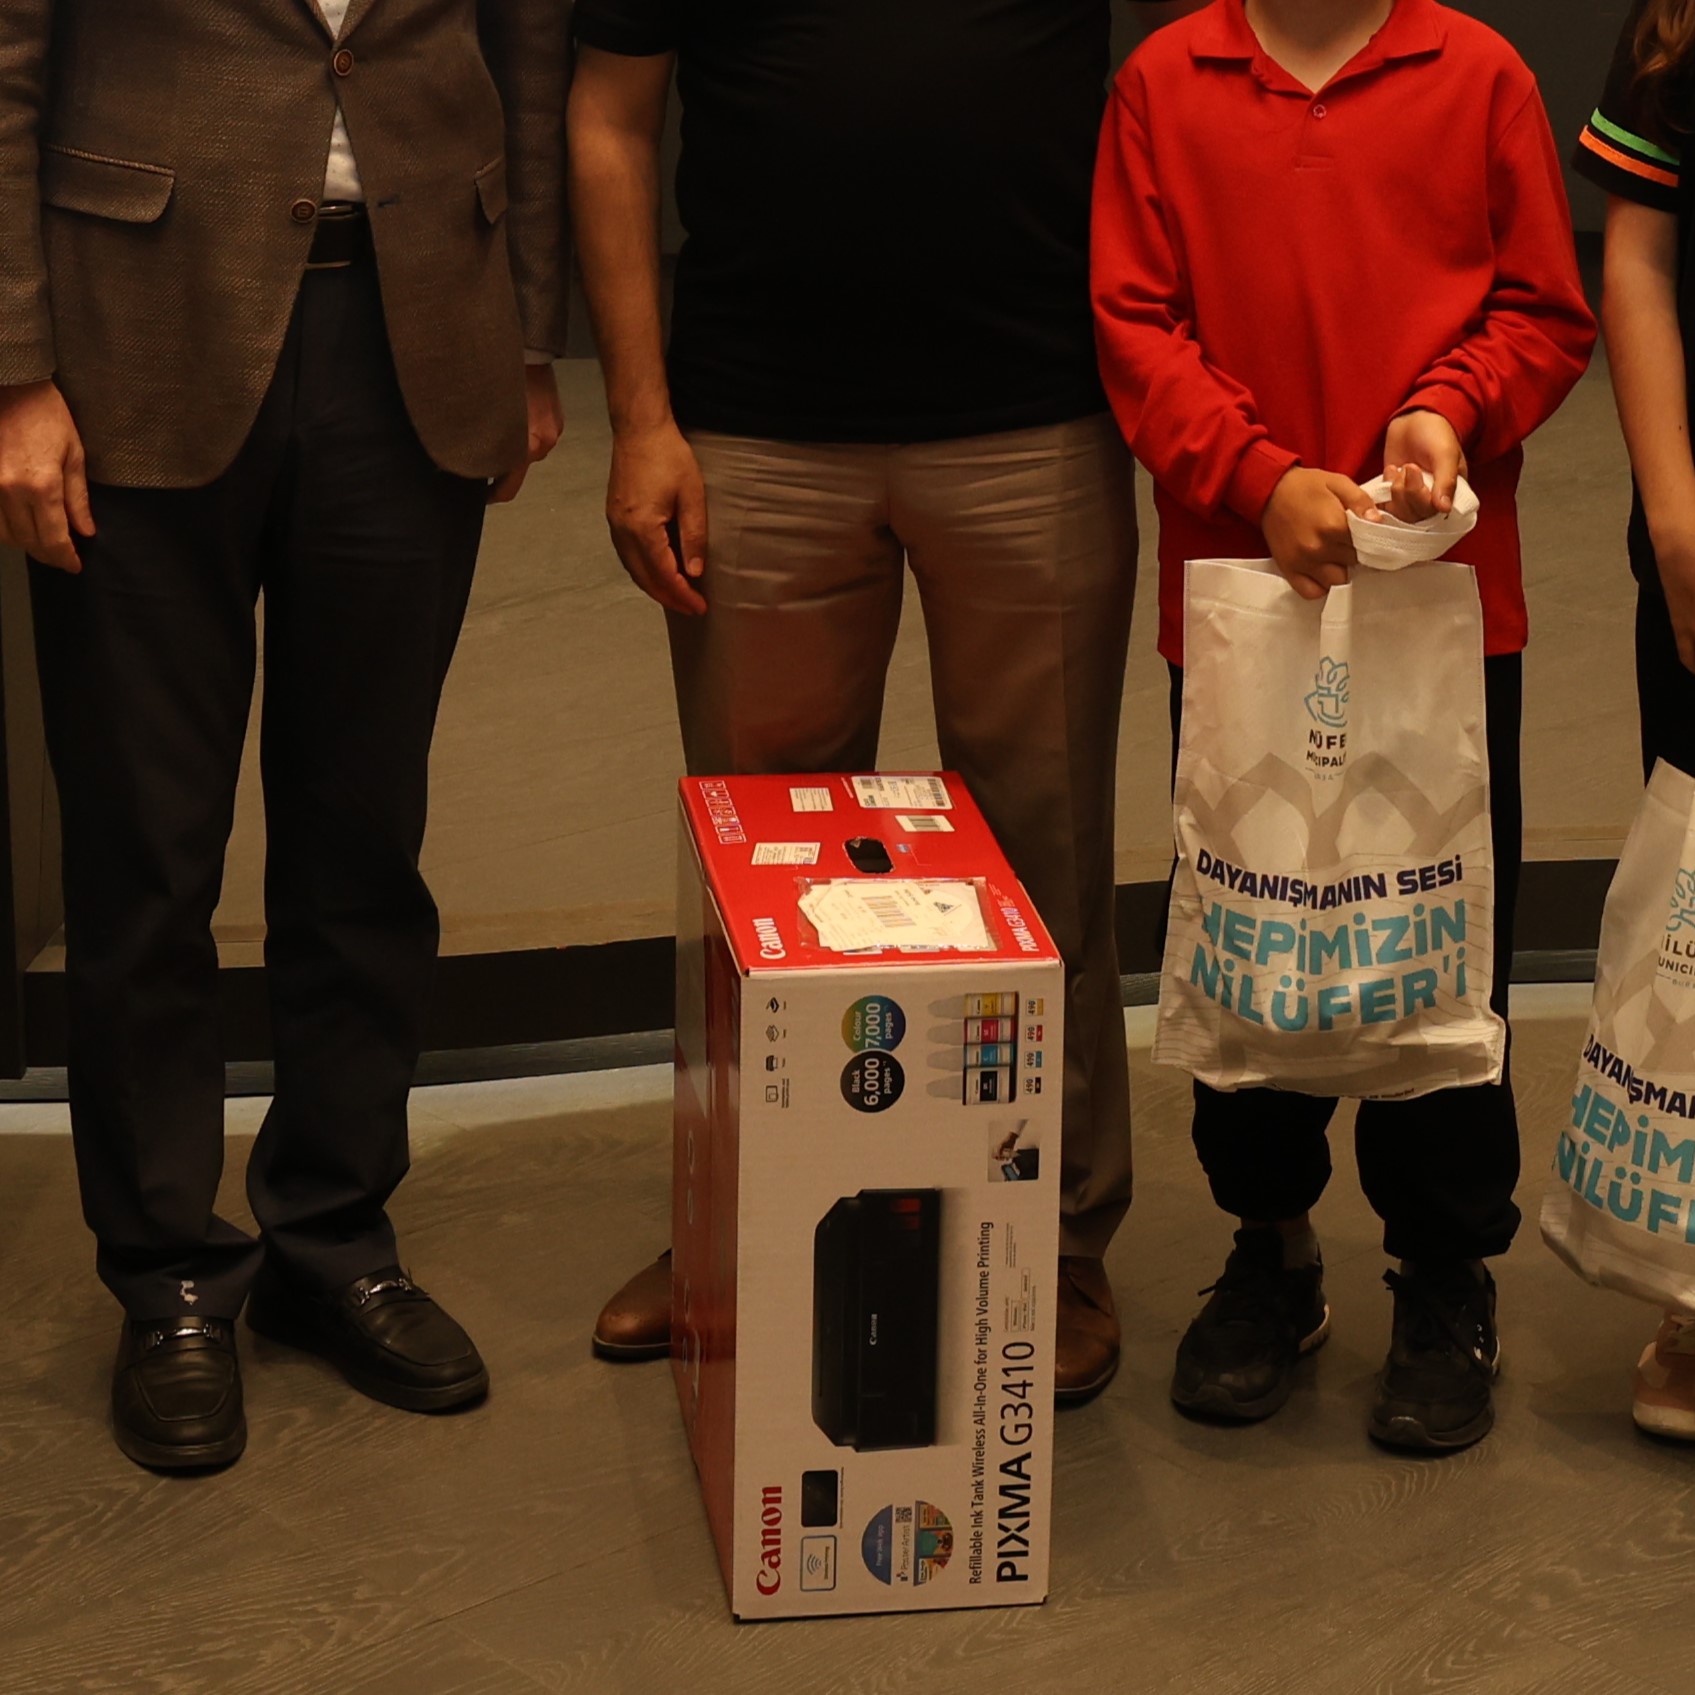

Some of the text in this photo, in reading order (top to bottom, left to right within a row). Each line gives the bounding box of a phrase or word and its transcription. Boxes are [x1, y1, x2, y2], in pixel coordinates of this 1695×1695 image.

[1196, 848, 1463, 911] DAYANIŞMANIN SESİ
[752, 917, 786, 960] Canon
[853, 1011, 862, 1041] Colour
[864, 1003, 881, 1048] 7,000
[852, 1069, 861, 1093] Black
[864, 1058, 881, 1106] 6,000
[868, 1313, 878, 1346] Canon
[969, 1222, 994, 1585] Refillable Ink Tank Wireless All-In-One for High Volume Printing
[996, 1341, 1035, 1583] PIXMA G3410
[756, 1485, 782, 1596] Canon
